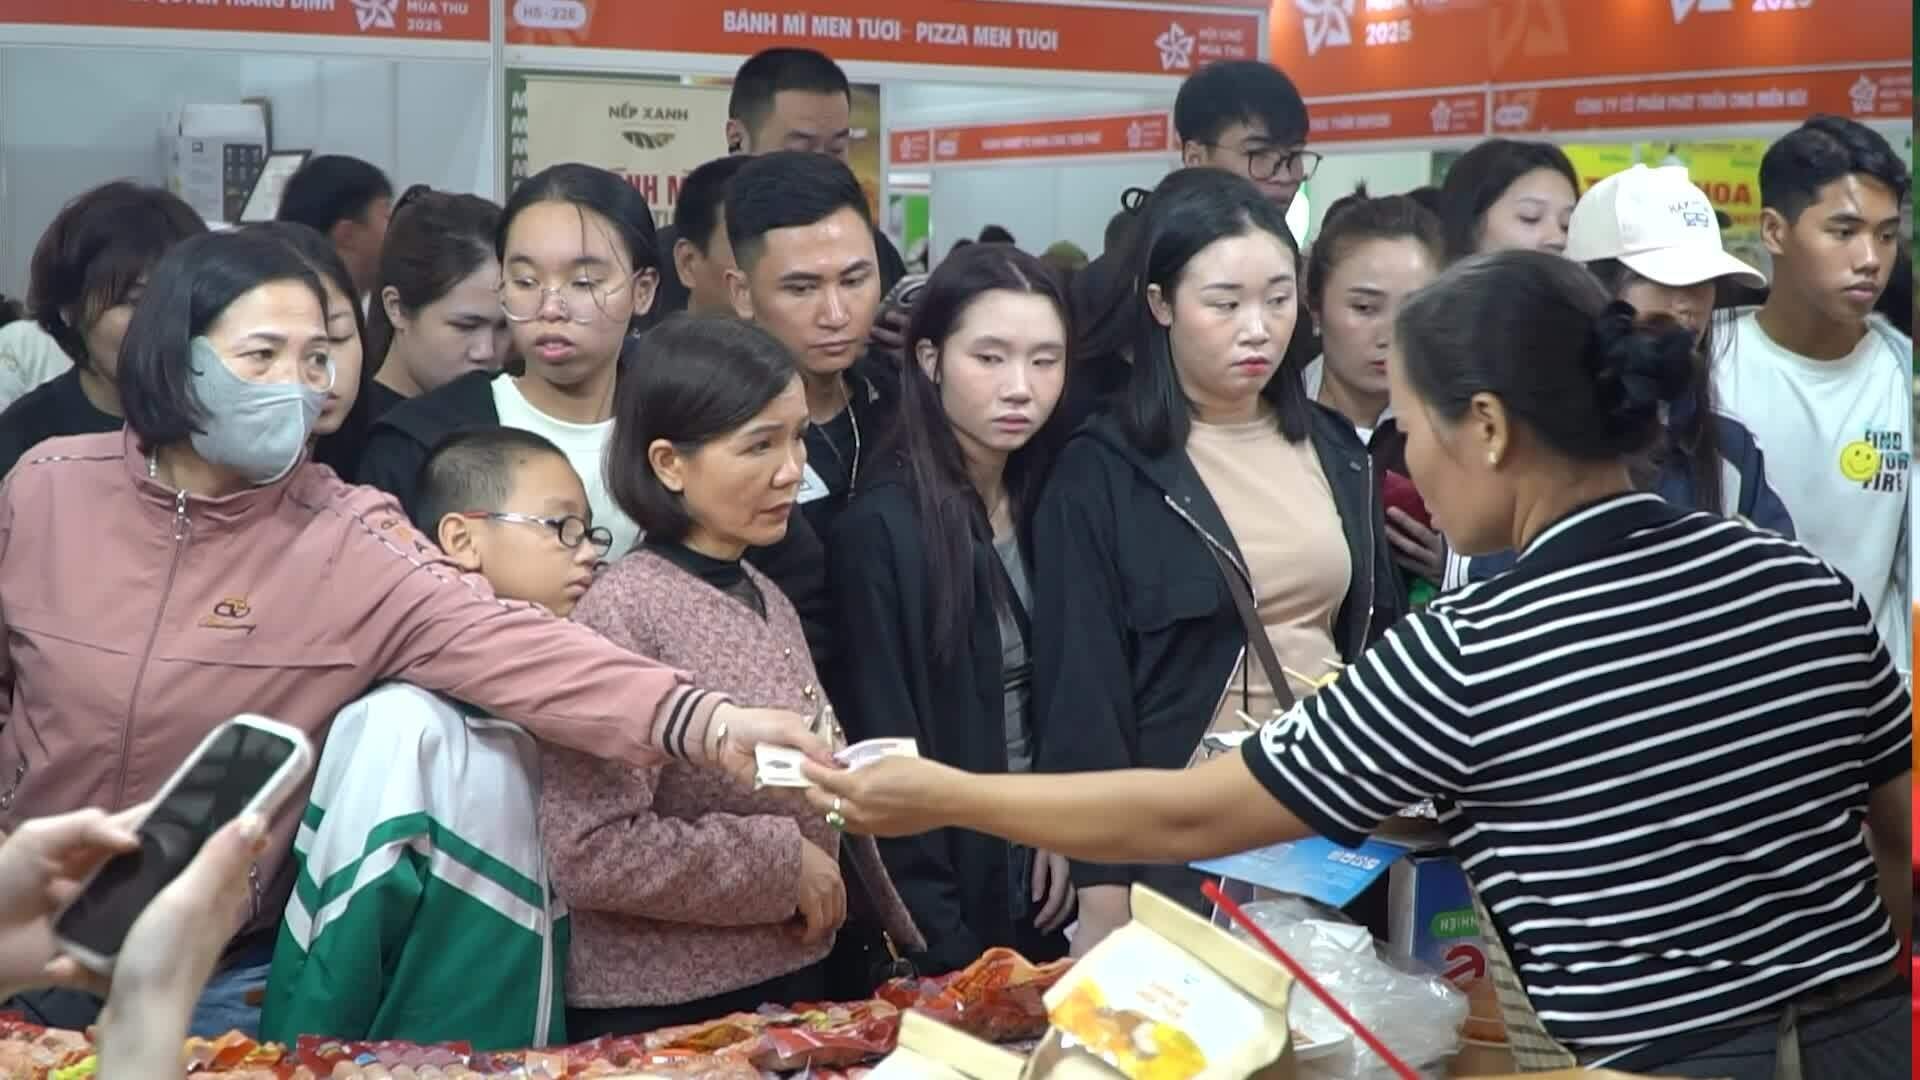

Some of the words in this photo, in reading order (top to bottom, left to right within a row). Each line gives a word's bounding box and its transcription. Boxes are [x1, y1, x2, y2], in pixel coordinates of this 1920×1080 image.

[722, 8, 777, 35] BÁNH
[811, 15, 852, 39] MEN
[916, 21, 969, 47] PIZZA
[973, 25, 1011, 49] MEN
[1365, 20, 1411, 46] 2025
[608, 101, 639, 120] NẾP
[642, 106, 689, 122] XANH
